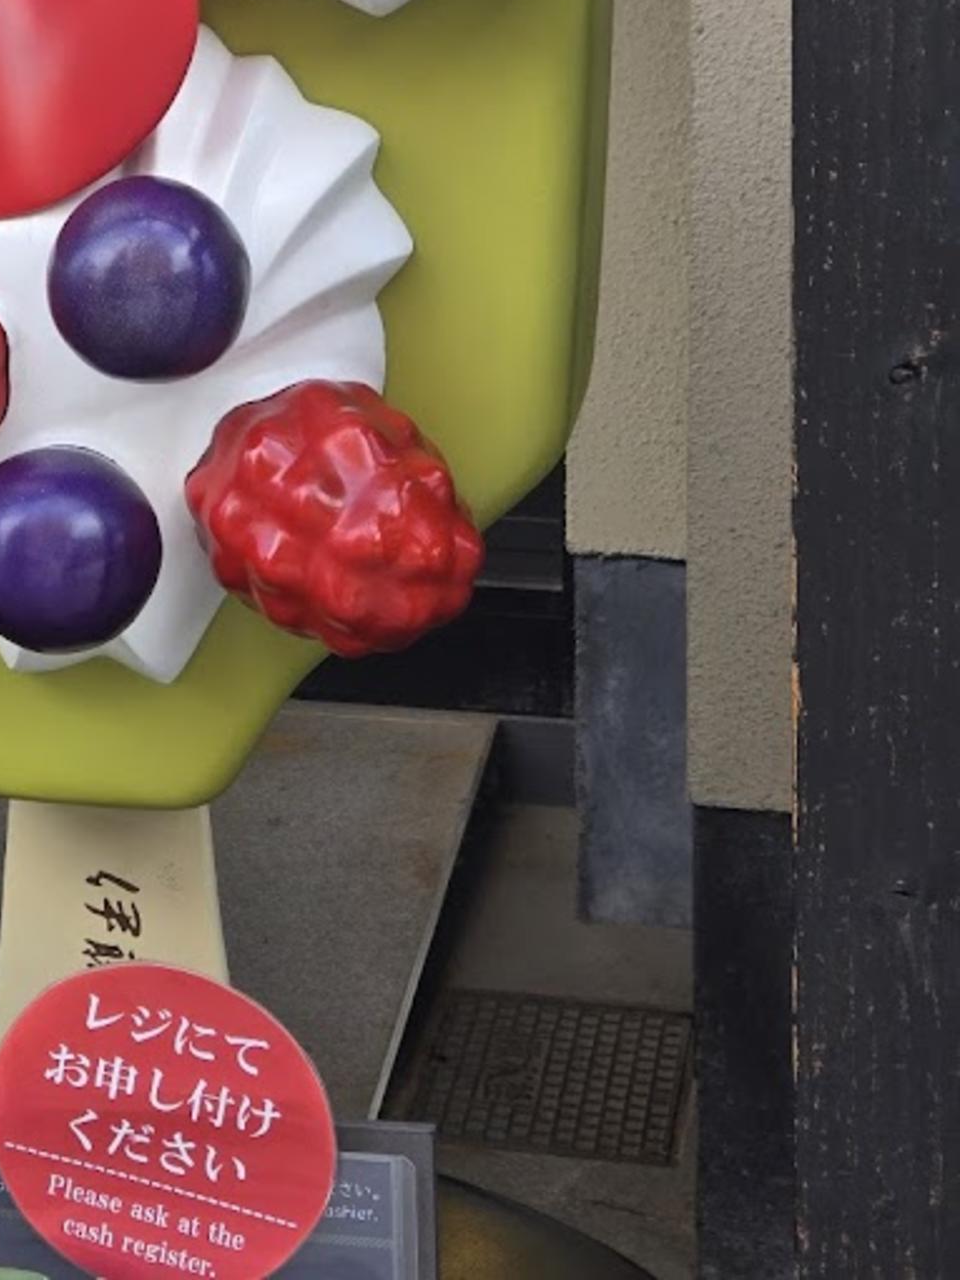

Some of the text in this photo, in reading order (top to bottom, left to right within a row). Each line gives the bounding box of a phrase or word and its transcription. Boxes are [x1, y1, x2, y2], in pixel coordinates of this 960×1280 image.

[86, 994, 270, 1076] レジにて
[44, 1043, 282, 1138] お申し付け
[68, 1109, 248, 1183] ください
[47, 1173, 246, 1251] Please ask at the
[62, 1217, 217, 1279] cash register.
